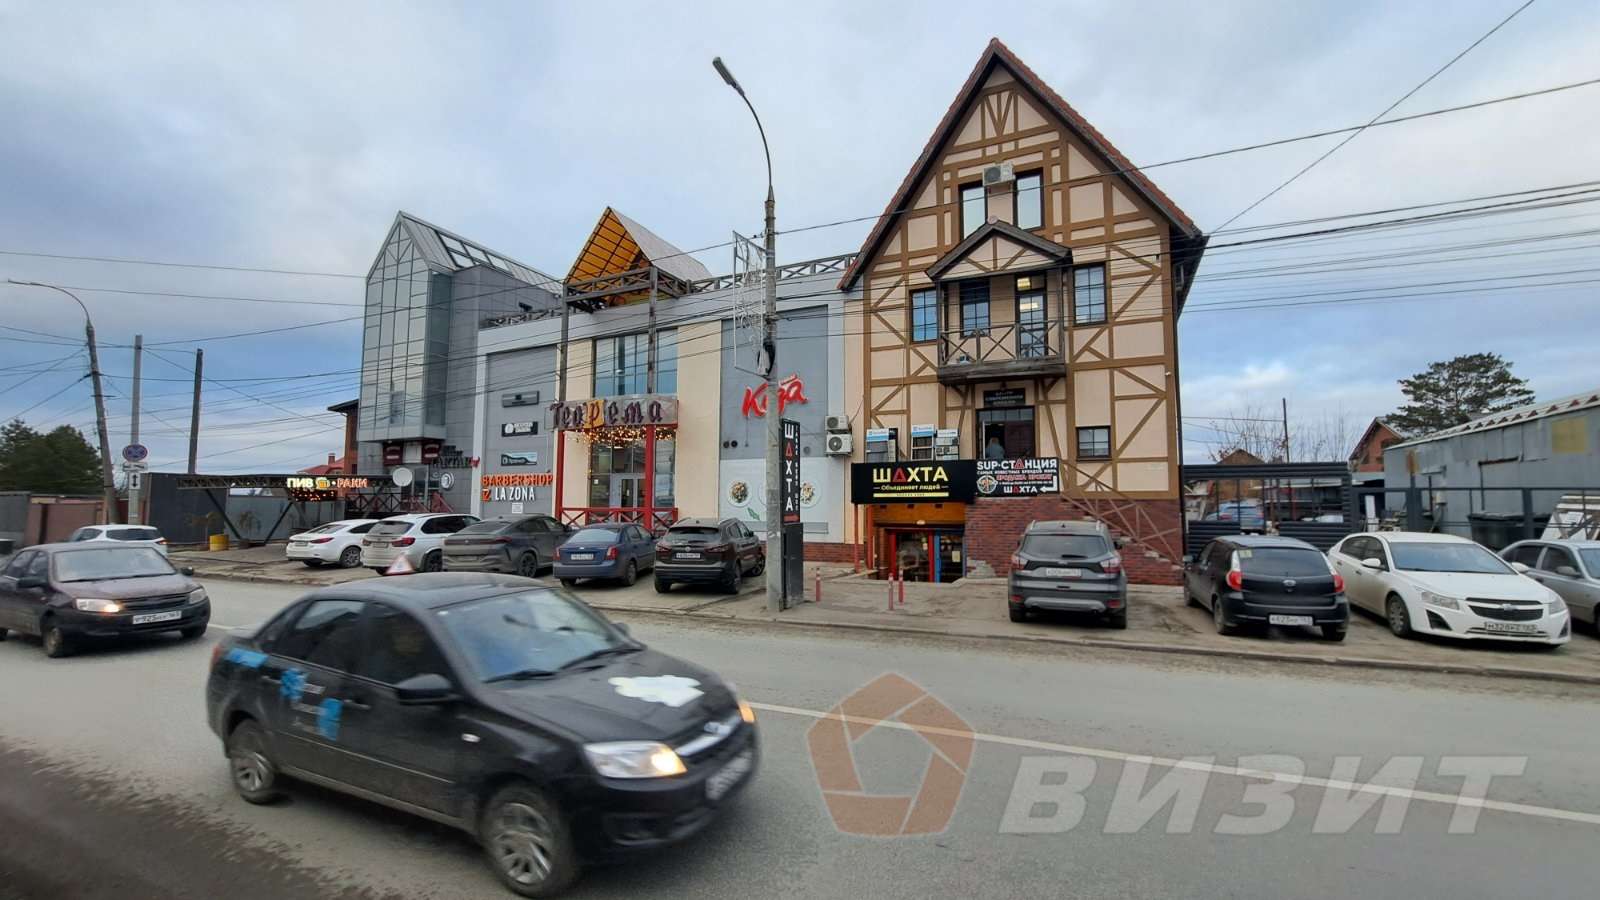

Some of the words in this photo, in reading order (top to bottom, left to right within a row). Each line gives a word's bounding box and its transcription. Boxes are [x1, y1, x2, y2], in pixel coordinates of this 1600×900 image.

[784, 423, 794, 512] ШАХТА
[873, 466, 949, 483] ШАХТА
[336, 477, 368, 488] РАКИ
[481, 473, 554, 487] BARBERSHOP
[919, 483, 941, 491] людей
[495, 487, 506, 501] LA
[509, 487, 535, 501] ZONA
